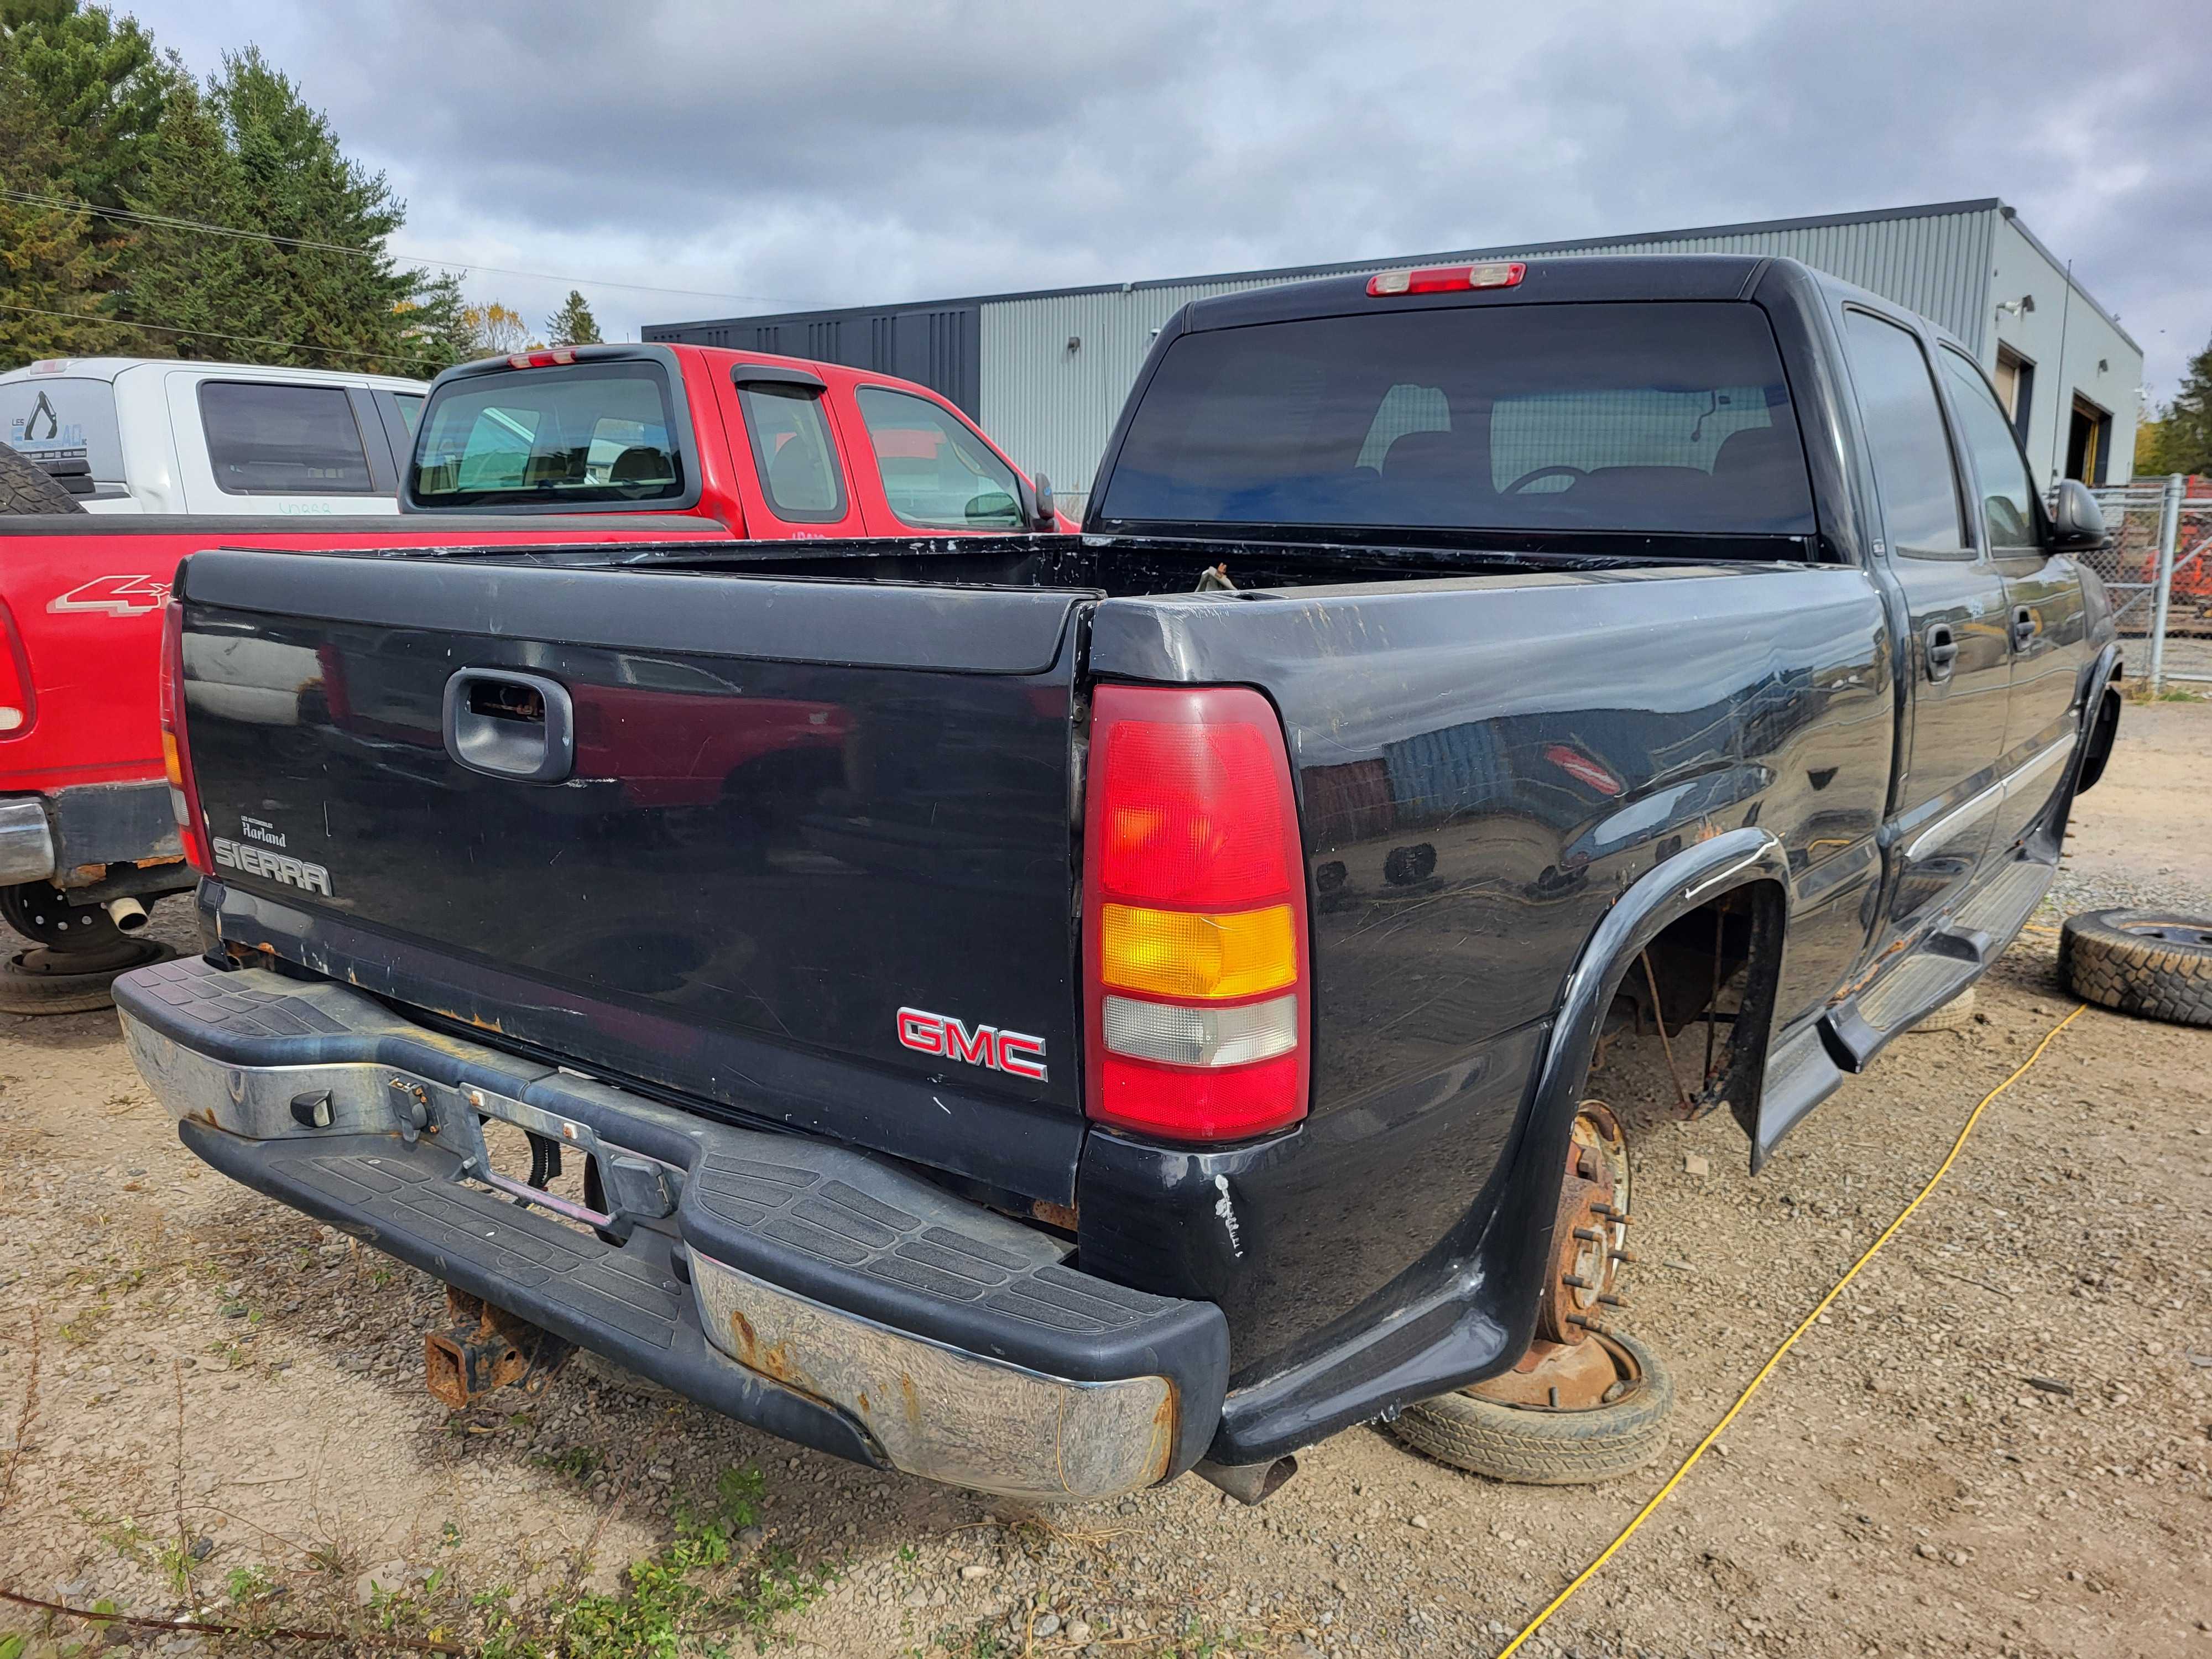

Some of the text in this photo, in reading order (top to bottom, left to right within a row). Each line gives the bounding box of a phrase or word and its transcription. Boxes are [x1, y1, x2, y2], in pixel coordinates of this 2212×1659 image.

[242, 821, 286, 848] Harland
[213, 837, 333, 898] SIERRA
[896, 1006, 1048, 1083] GMC
